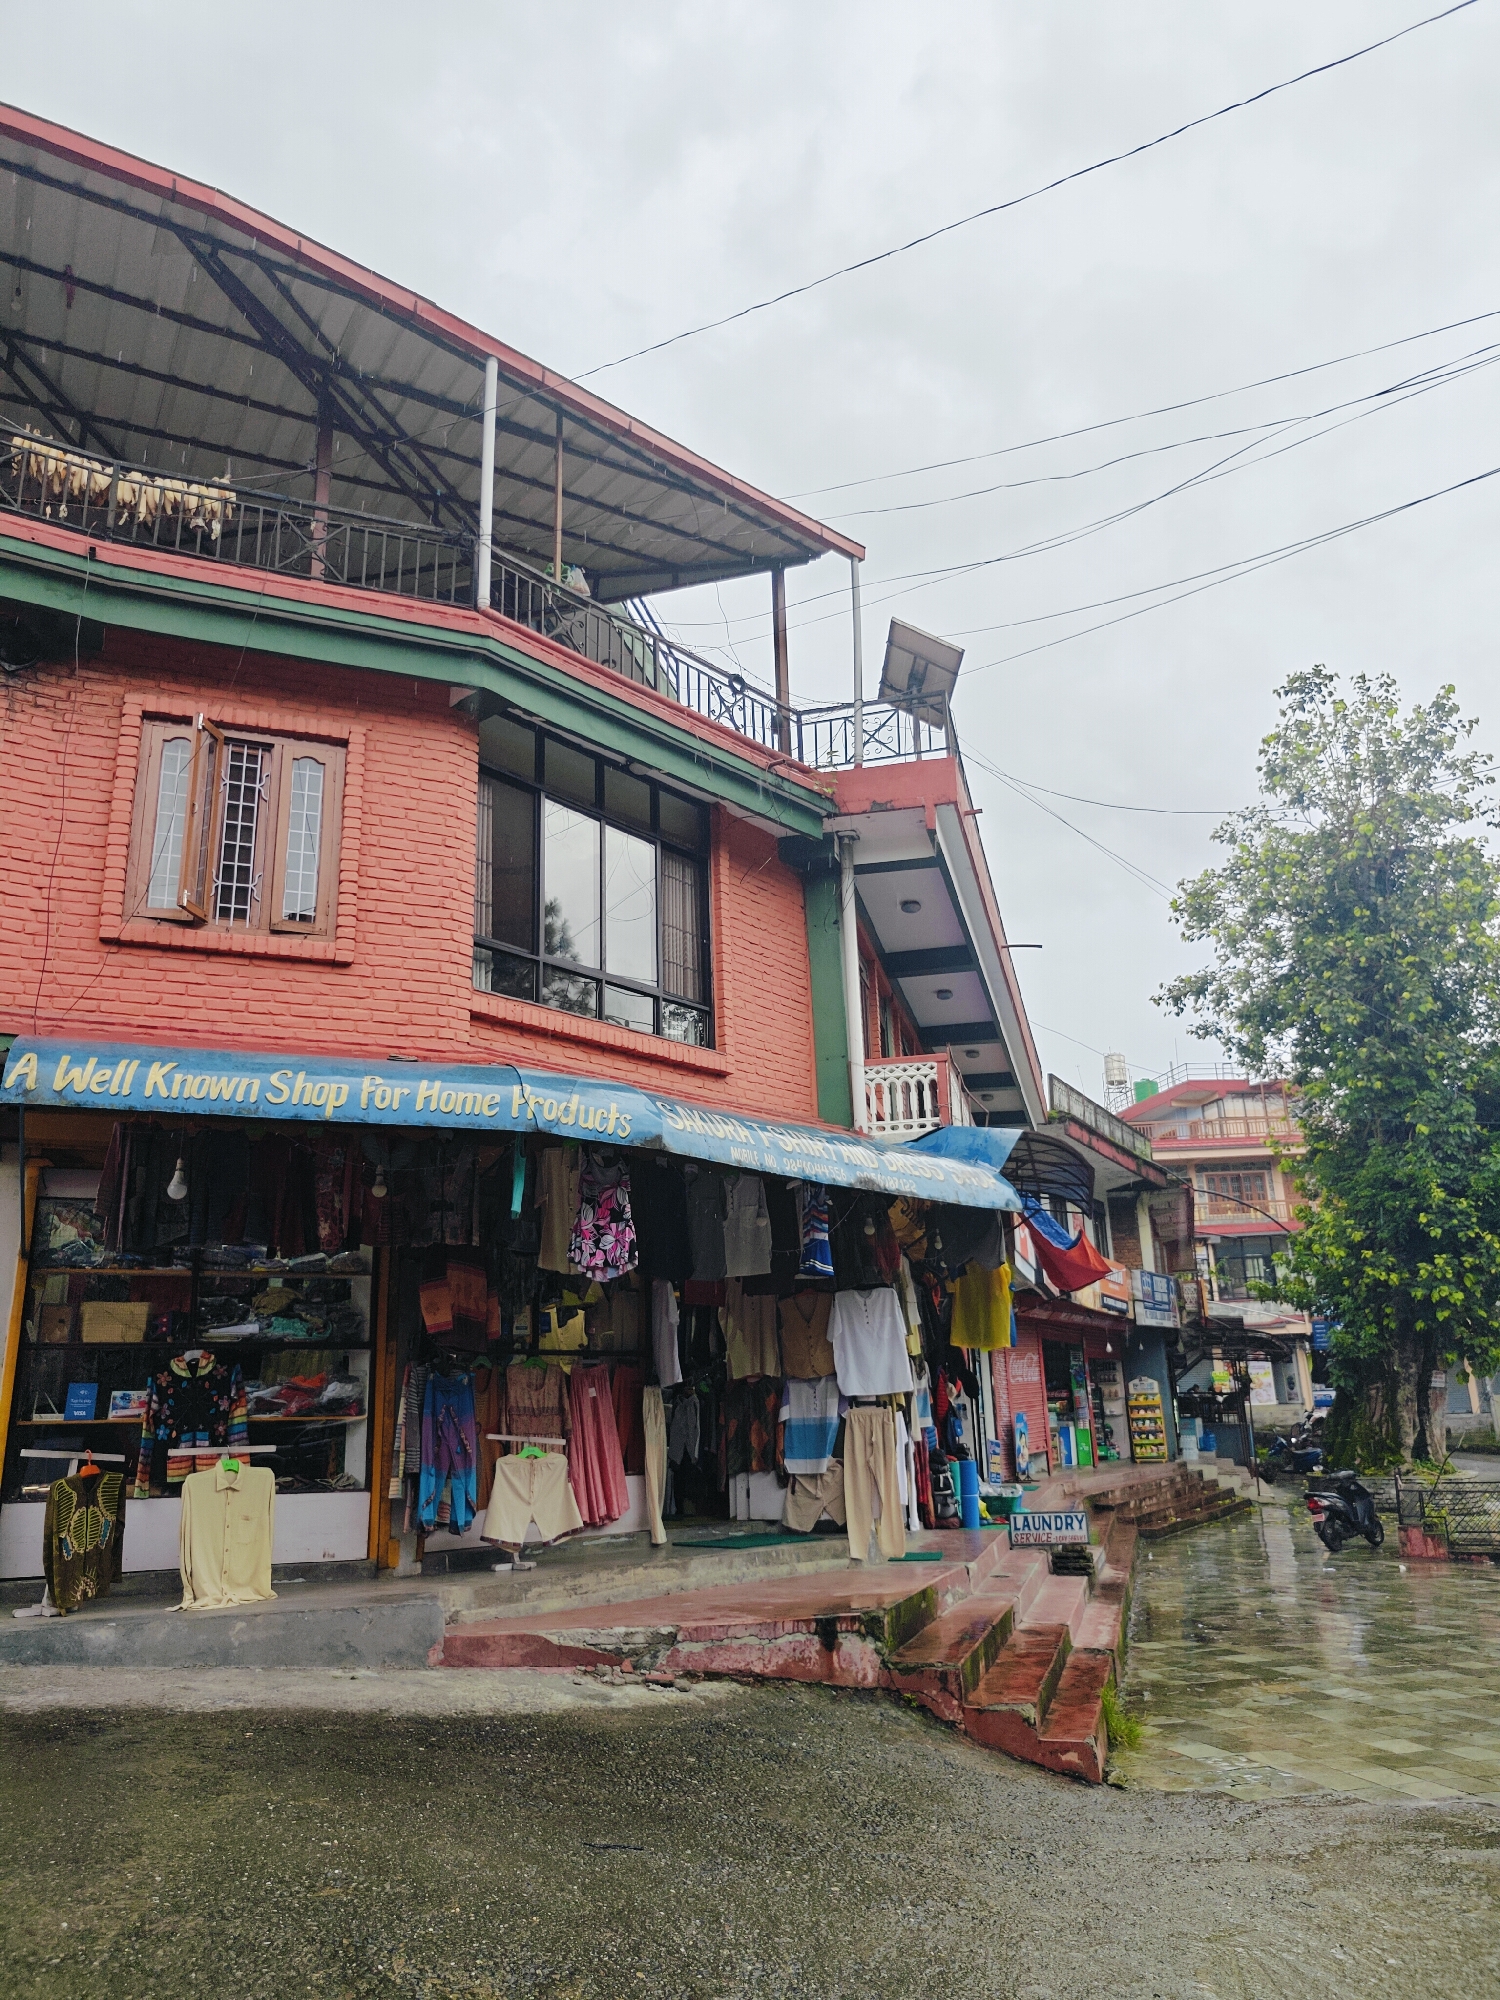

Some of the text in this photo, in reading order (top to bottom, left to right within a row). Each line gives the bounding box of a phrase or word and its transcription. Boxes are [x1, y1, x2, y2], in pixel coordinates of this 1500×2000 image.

[4, 1052, 633, 1139] A Well Known Shop For Home Products
[655, 1101, 756, 1146] SAKURA
[744, 1121, 838, 1162] T-SHIRT
[833, 1139, 880, 1170] AND
[879, 1151, 945, 1182] DRESS
[730, 1146, 760, 1166] MOBILE
[1013, 1515, 1085, 1531] LAUNDRY
[1013, 1533, 1053, 1543] SERVICE
